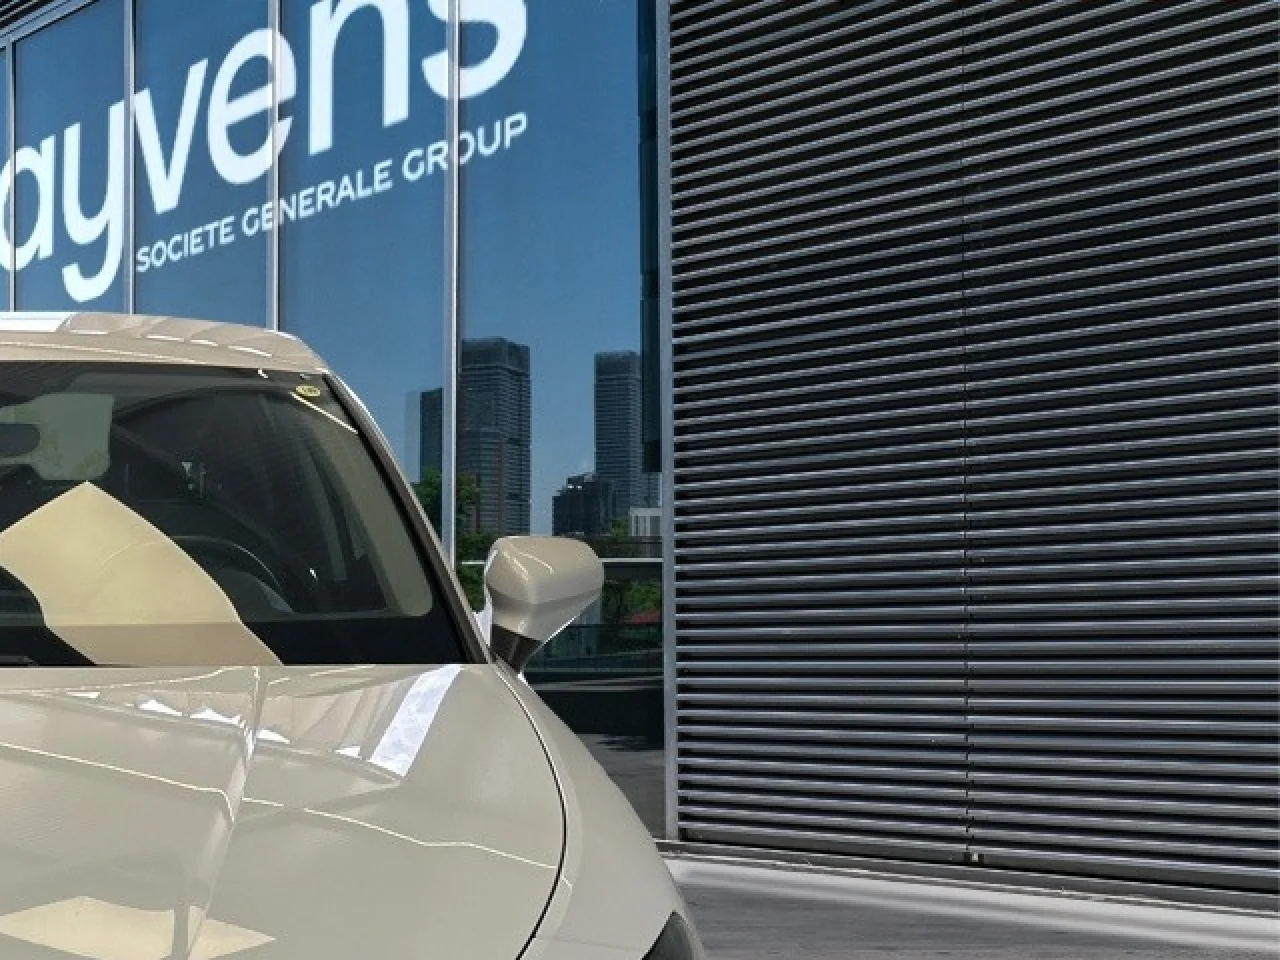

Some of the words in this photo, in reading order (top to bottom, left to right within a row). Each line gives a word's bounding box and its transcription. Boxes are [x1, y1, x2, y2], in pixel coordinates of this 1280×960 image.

[136, 215, 236, 273] SOCIETE
[241, 159, 394, 238] GENERALE
[401, 112, 528, 182] GROUP
